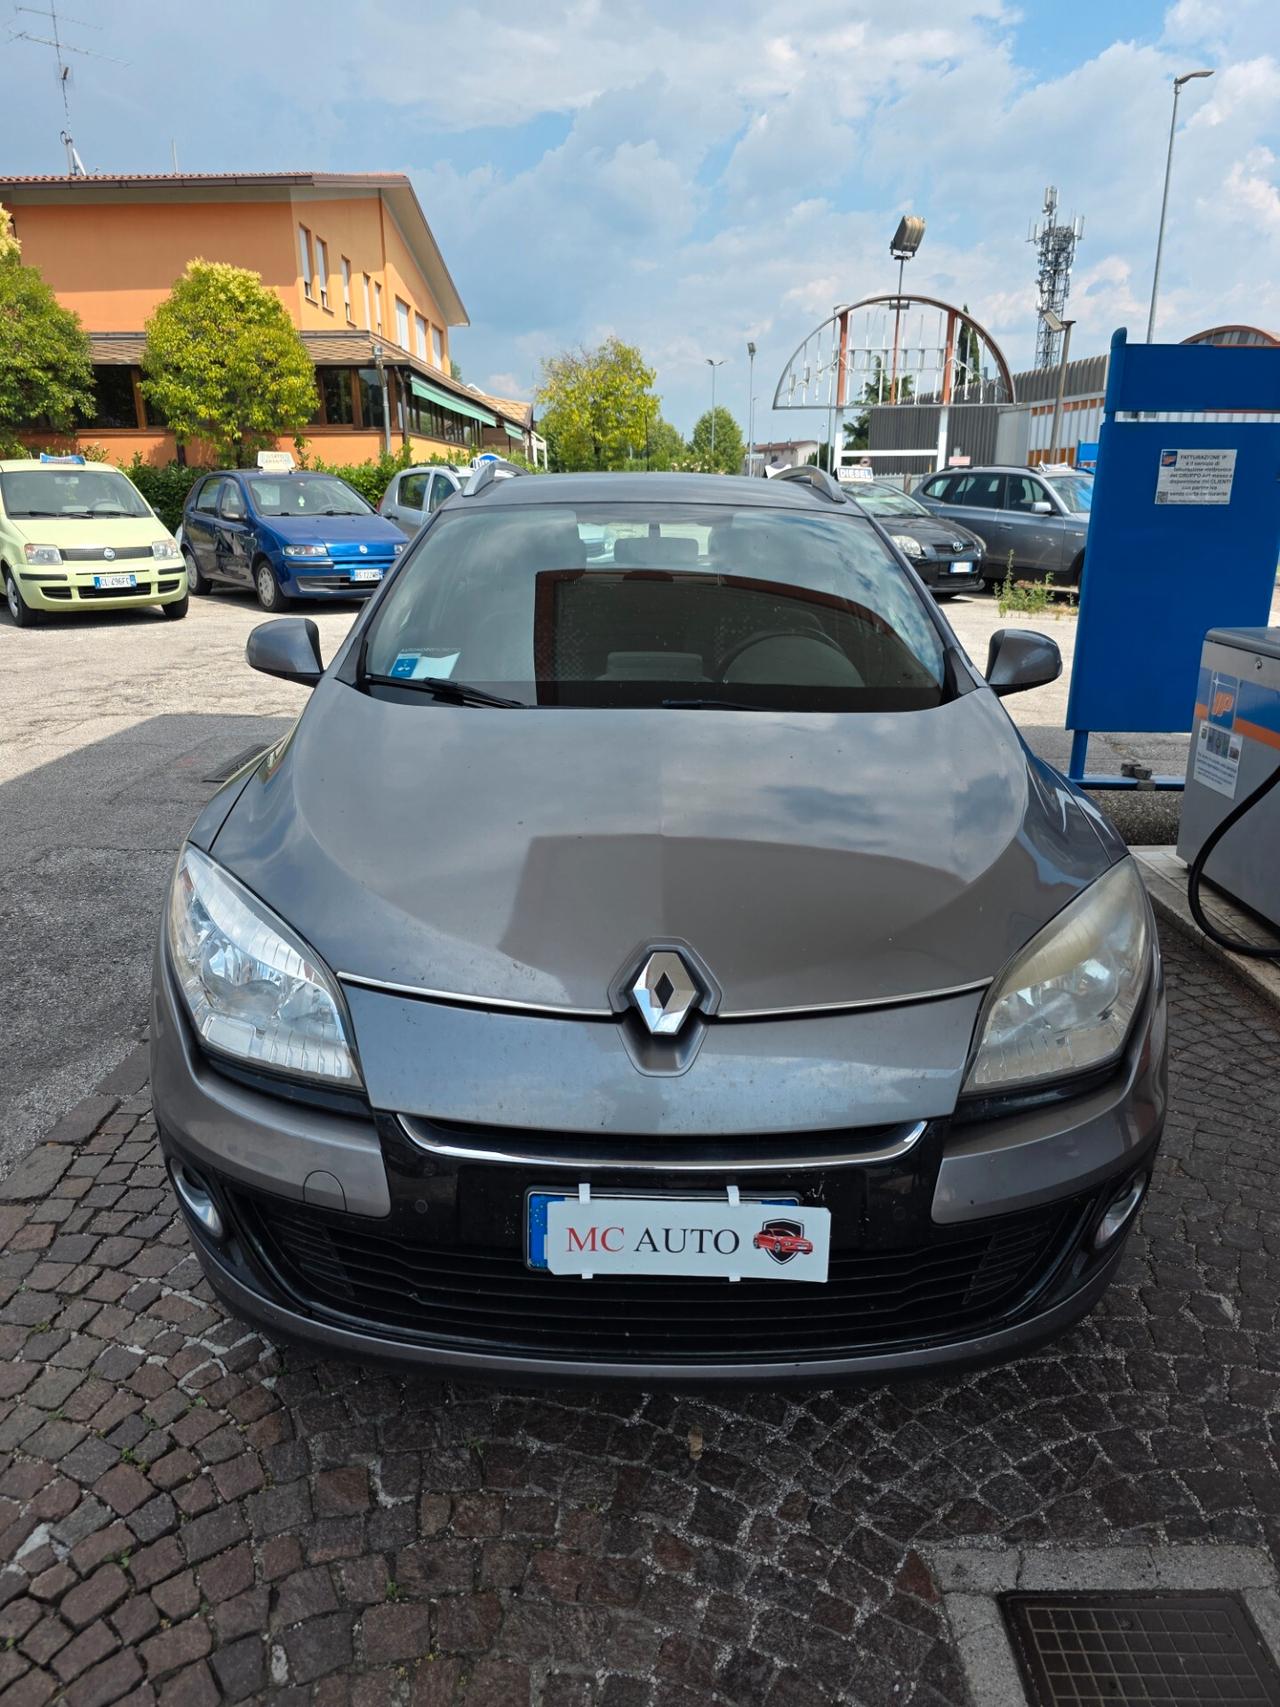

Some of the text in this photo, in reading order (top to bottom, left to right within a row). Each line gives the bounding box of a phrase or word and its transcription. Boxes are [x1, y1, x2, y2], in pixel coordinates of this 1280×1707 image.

[839, 468, 871, 478] DIESEL
[565, 1226, 741, 1255] MC AUTO
